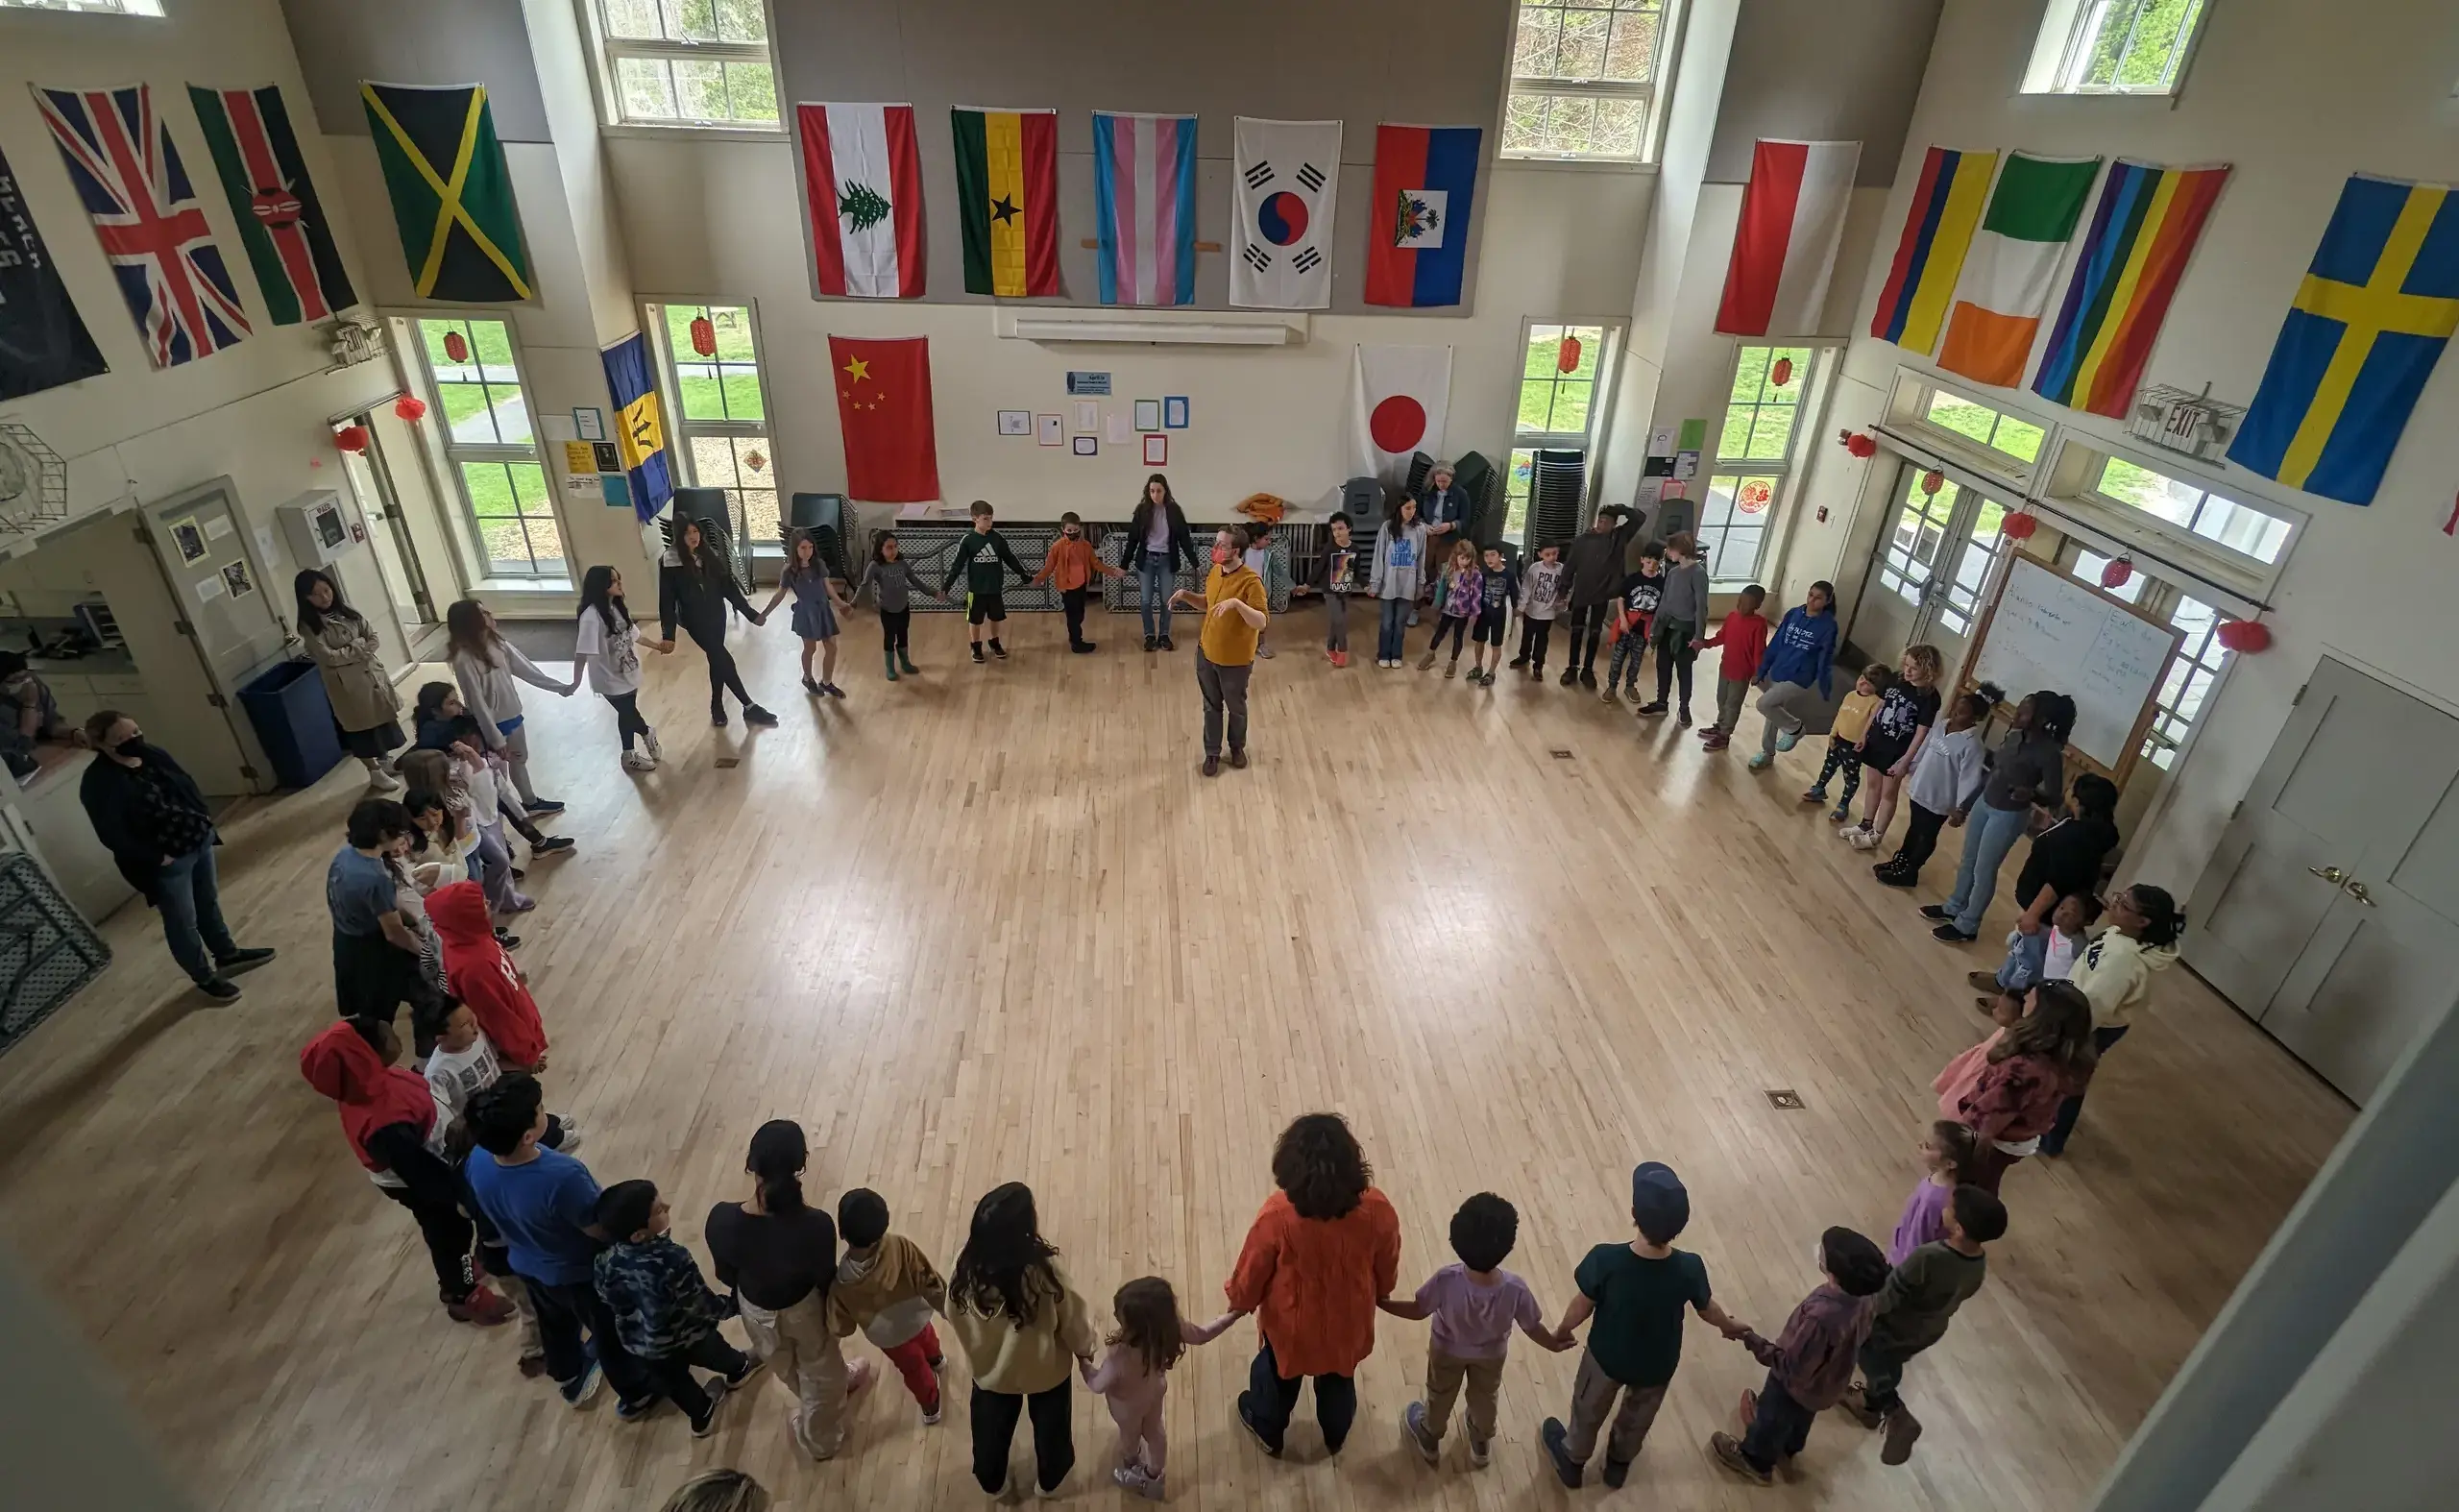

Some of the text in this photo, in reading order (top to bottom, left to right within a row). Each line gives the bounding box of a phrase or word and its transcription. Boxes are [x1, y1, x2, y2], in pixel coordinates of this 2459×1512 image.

[343, 327, 364, 353] EXIT
[2165, 405, 2202, 439] EXIT
[321, 502, 331, 513] AED
[1539, 572, 1560, 583] POLO
[1331, 582, 1351, 592] NASA
